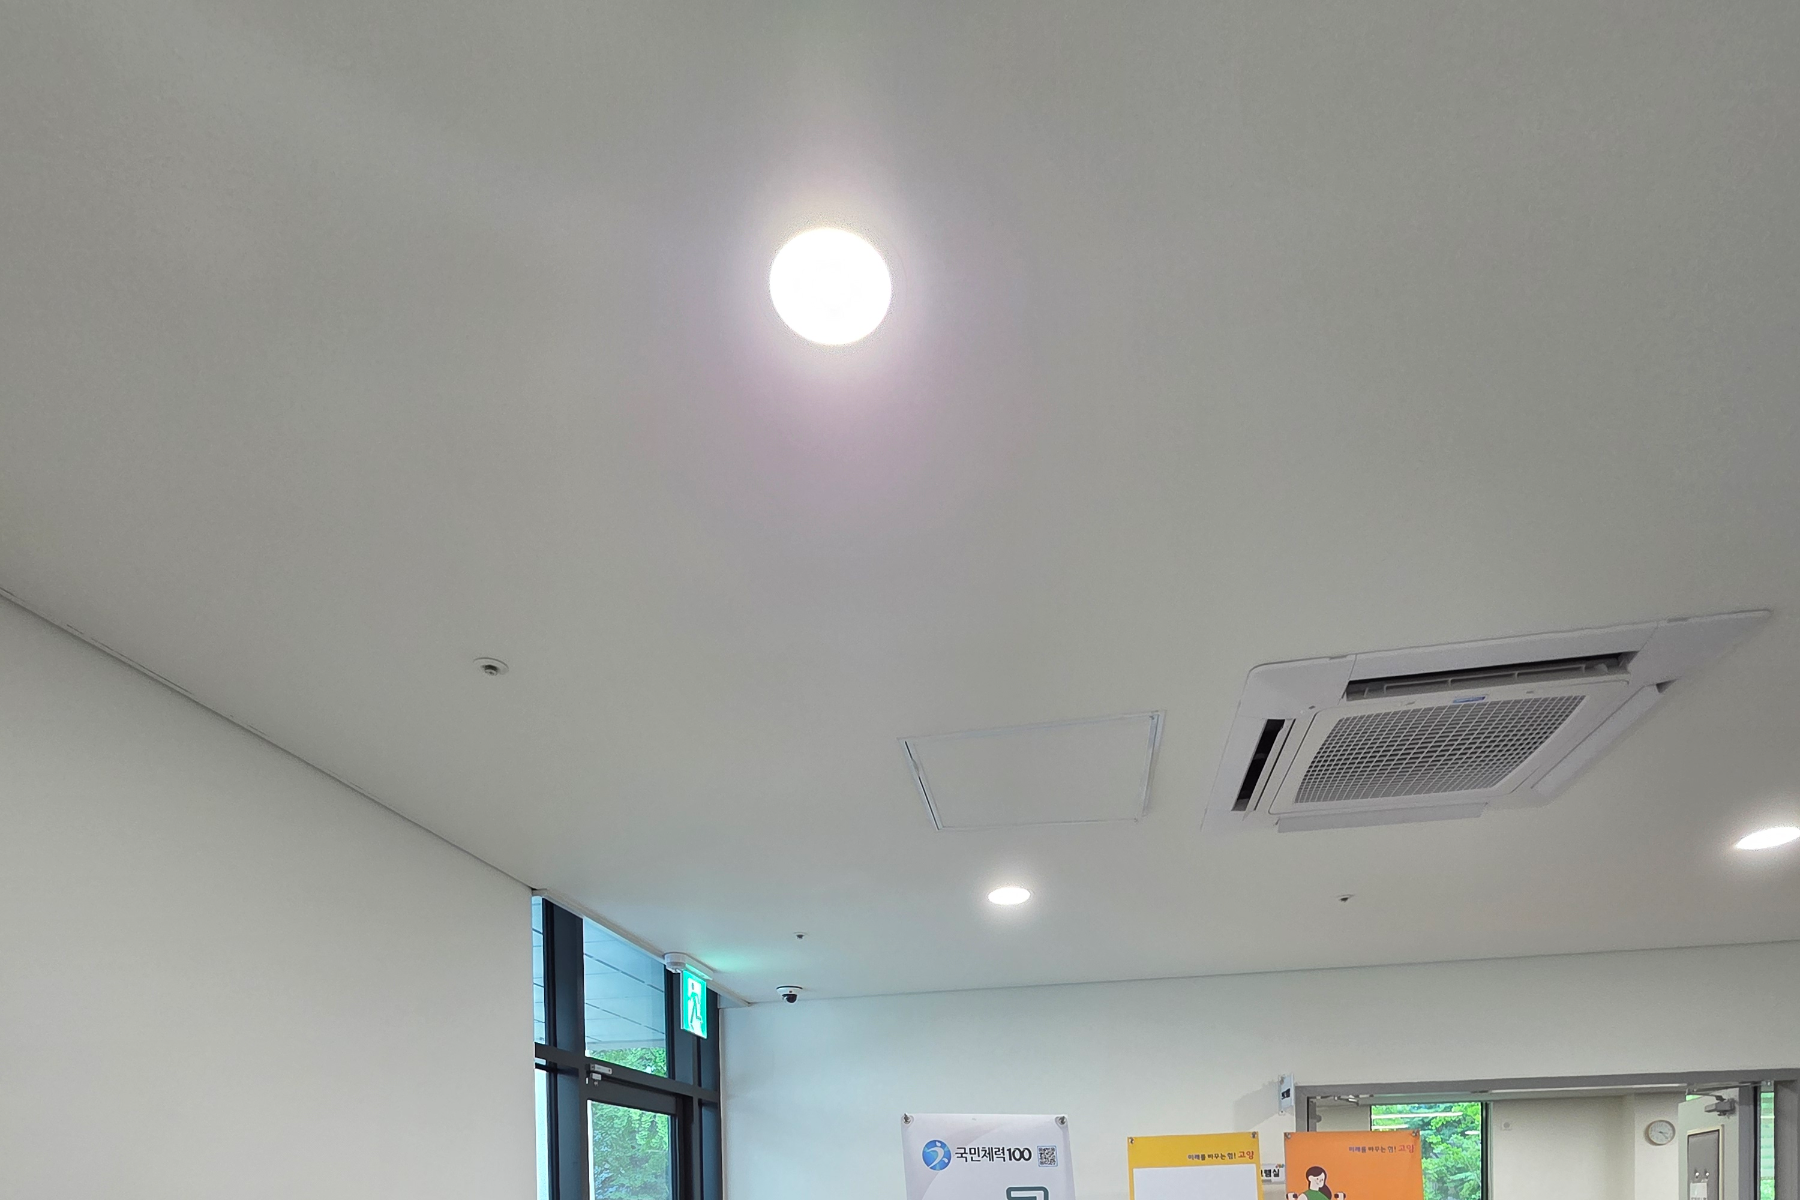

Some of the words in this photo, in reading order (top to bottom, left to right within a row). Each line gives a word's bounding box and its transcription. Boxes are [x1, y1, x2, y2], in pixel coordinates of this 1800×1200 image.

[1398, 1144, 1415, 1153] 고양
[955, 1146, 1032, 1163] 국민체력100
[1238, 1150, 1255, 1160] 고양
